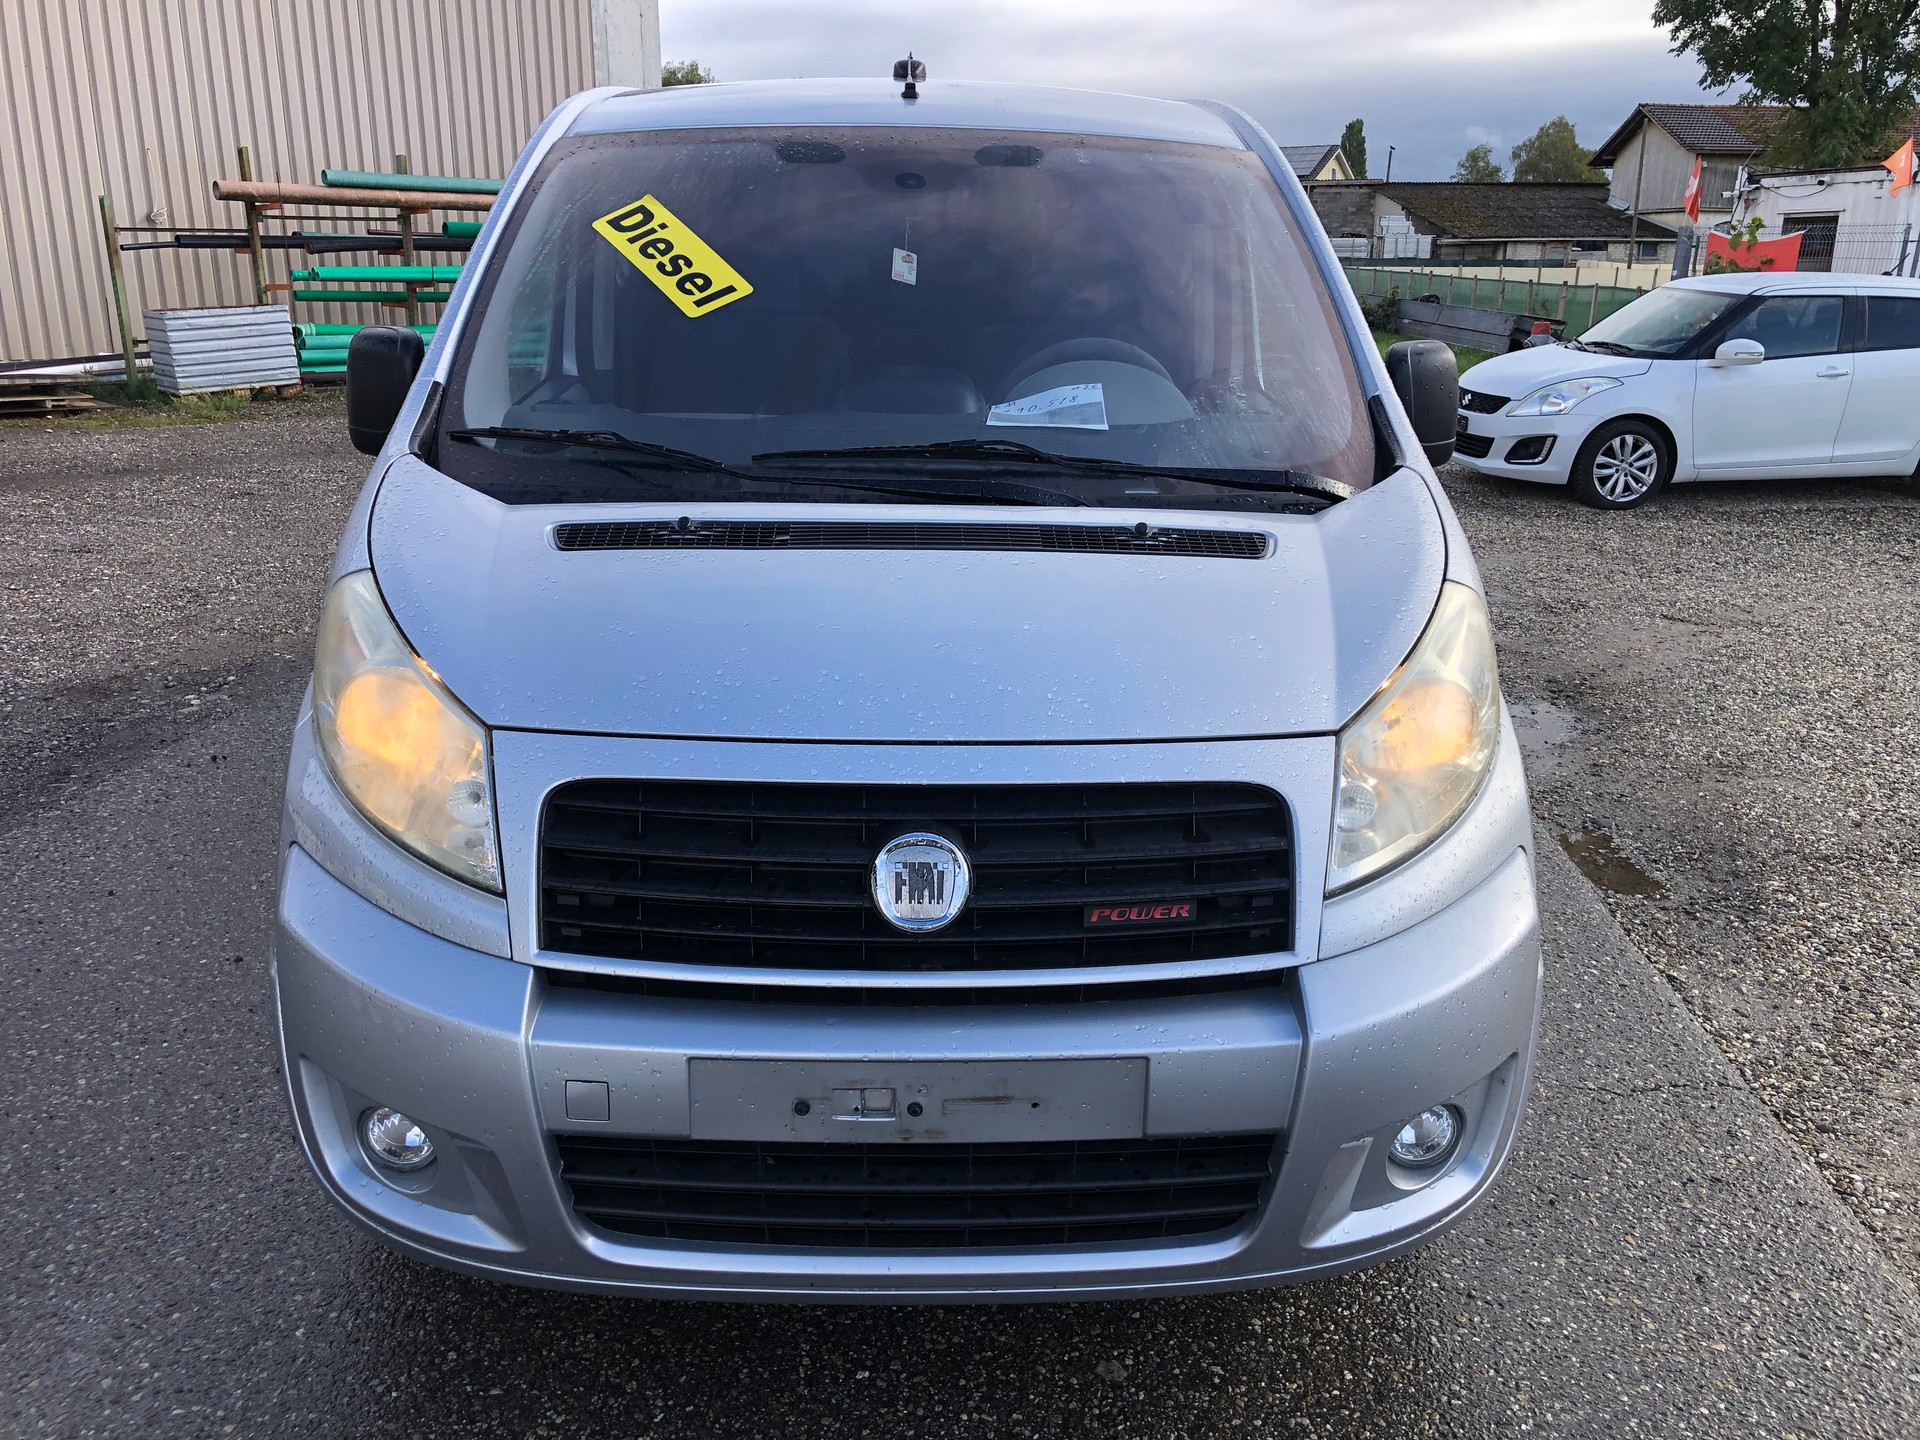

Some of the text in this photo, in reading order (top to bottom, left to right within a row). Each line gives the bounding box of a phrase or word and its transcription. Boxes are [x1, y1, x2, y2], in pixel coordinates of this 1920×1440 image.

[606, 204, 738, 309] Diesel
[894, 861, 950, 905] FIAT
[1090, 904, 1191, 922] POWER
